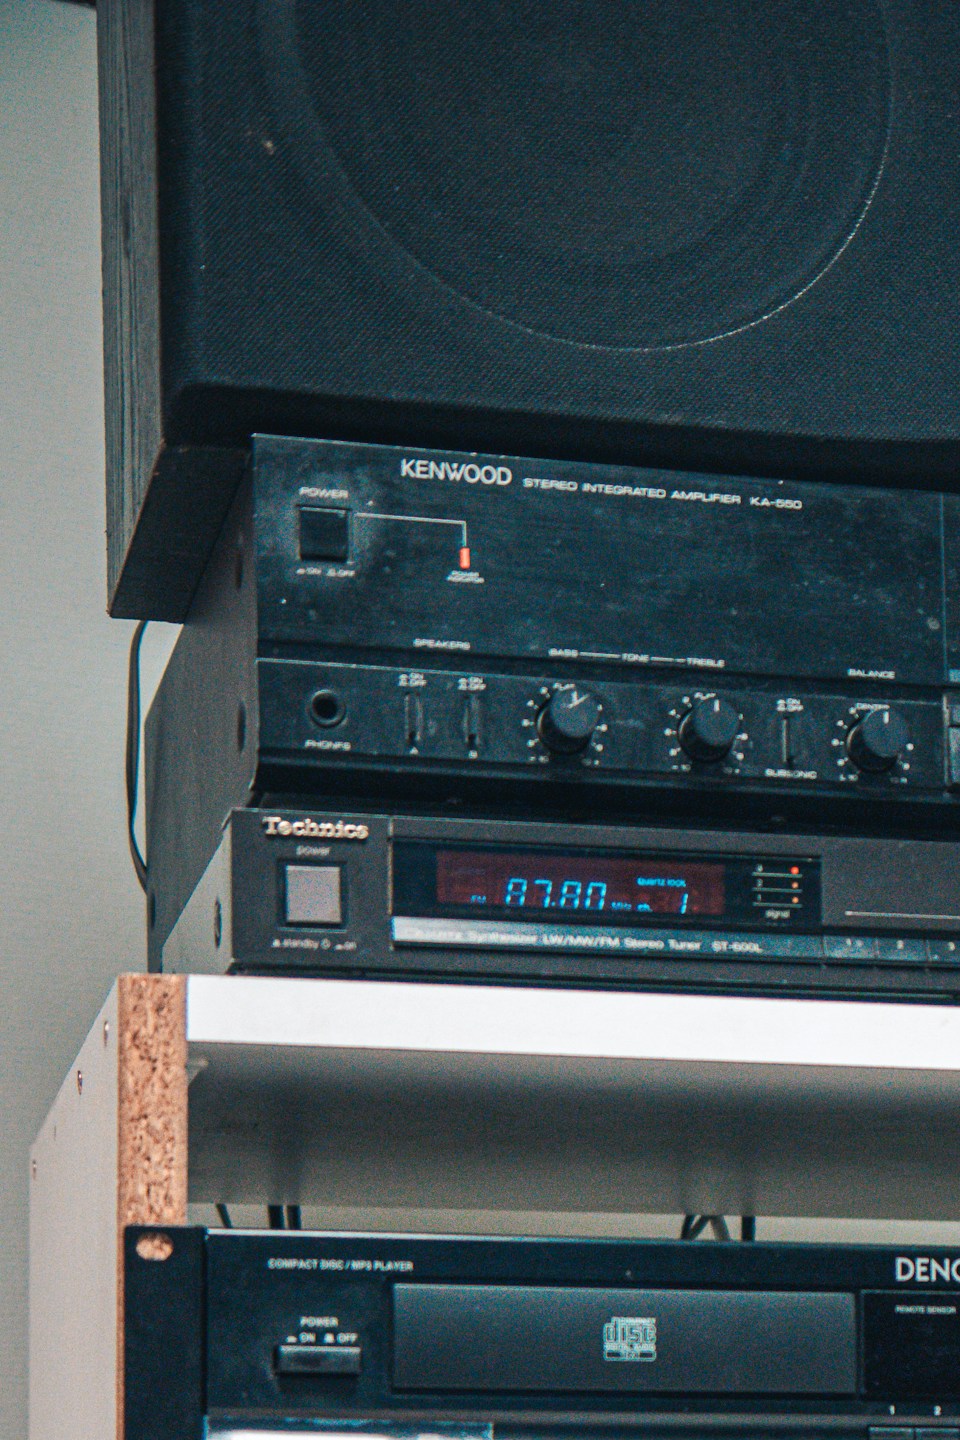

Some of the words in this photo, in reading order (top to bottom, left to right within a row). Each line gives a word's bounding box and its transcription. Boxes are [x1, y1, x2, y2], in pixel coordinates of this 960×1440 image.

[401, 459, 512, 485] KENWOOD
[523, 478, 577, 491] STEREO
[582, 483, 666, 498] INTEGRATED
[672, 490, 741, 504] AMPLIFIER
[299, 487, 348, 499] POWER
[413, 638, 471, 650] SPEAKERS
[549, 648, 578, 658] BASS
[622, 653, 649, 663] TONE
[687, 658, 725, 668] TREBLE
[848, 669, 895, 680] BALANCE
[305, 740, 351, 751] PHONES
[264, 817, 368, 839] Technics
[624, 937, 664, 950] Stereo
[668, 940, 701, 951] Tuner
[268, 1258, 318, 1269] COMPACT
[374, 1261, 413, 1271] PLAYER
[300, 1316, 338, 1327] POWER
[300, 1333, 316, 1342] ON
[337, 1333, 358, 1343] OFF
